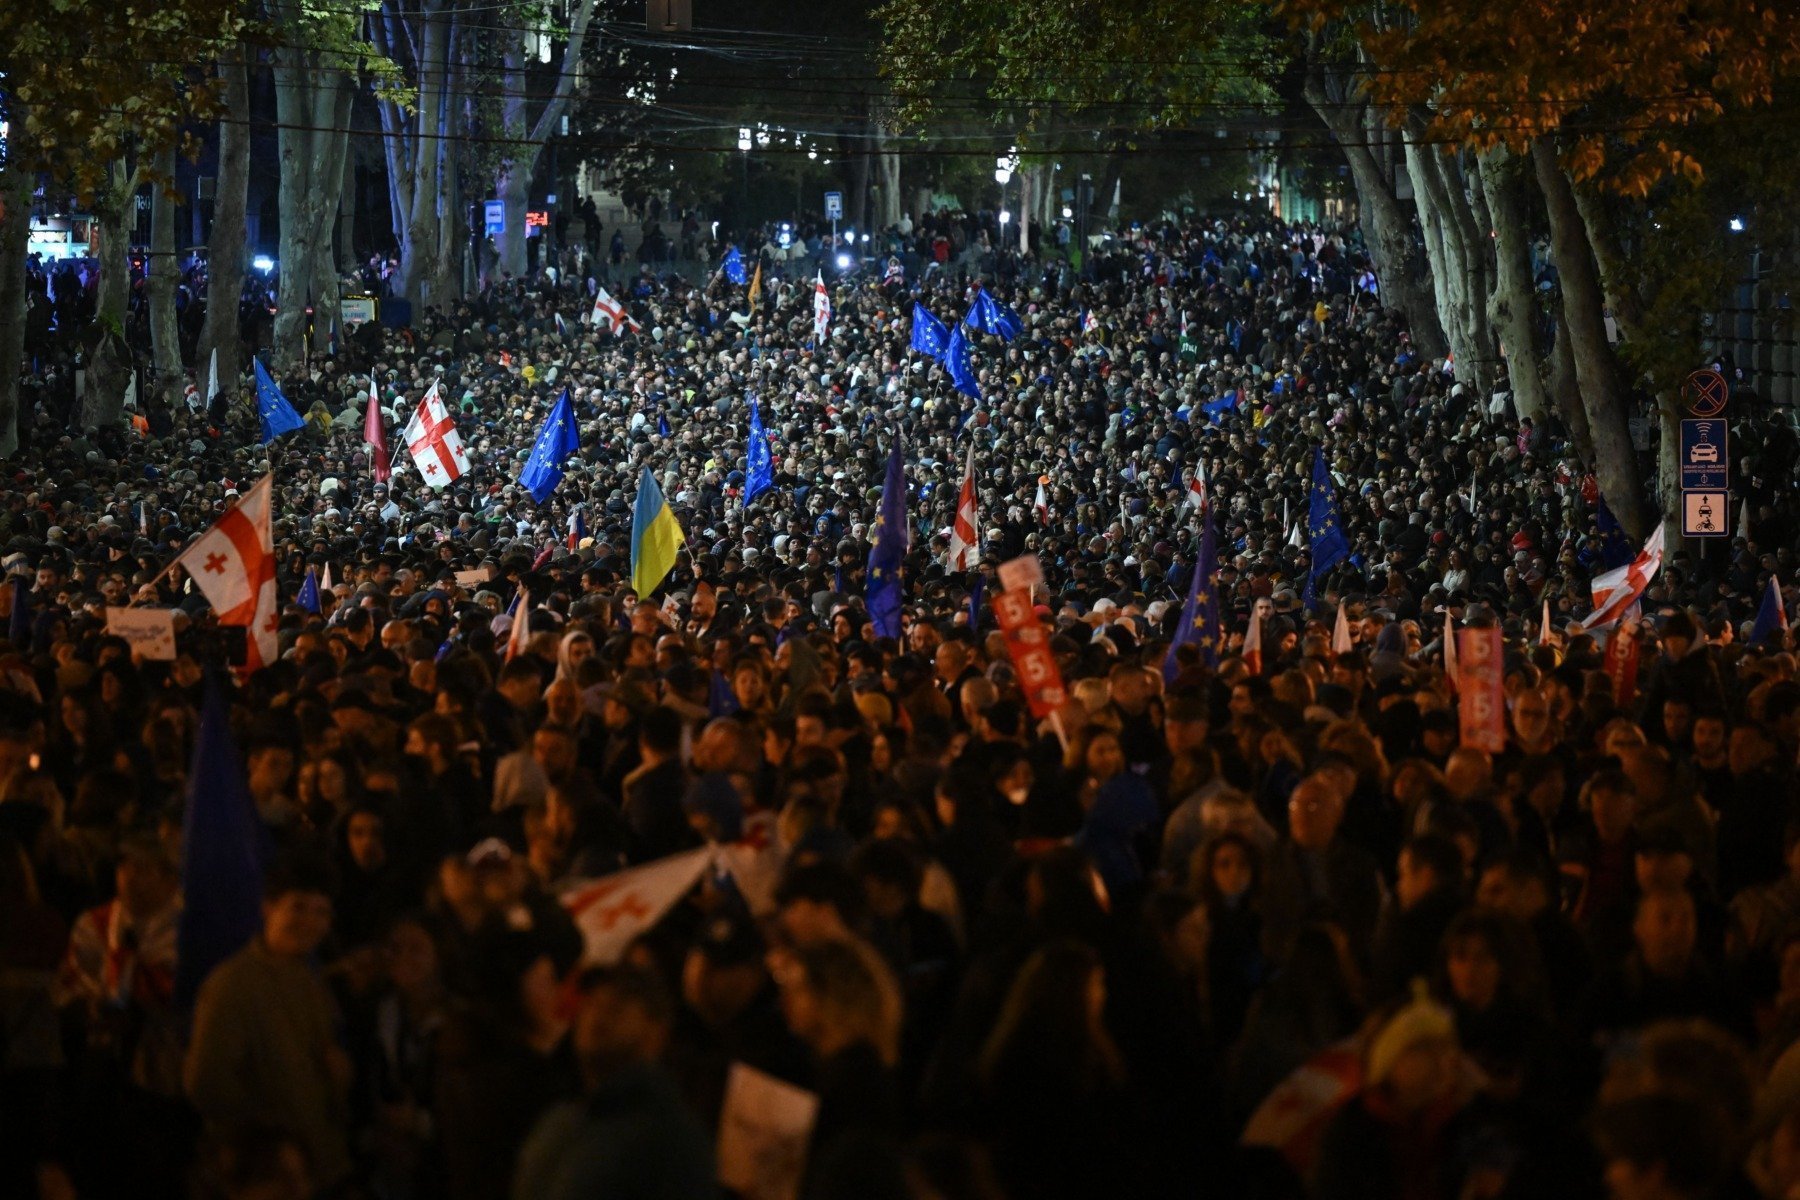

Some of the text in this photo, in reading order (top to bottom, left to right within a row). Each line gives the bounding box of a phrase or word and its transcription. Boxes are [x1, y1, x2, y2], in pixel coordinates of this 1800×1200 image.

[1004, 596, 1023, 625] 5
[1474, 632, 1491, 659] 5
[1025, 652, 1045, 682] 5
